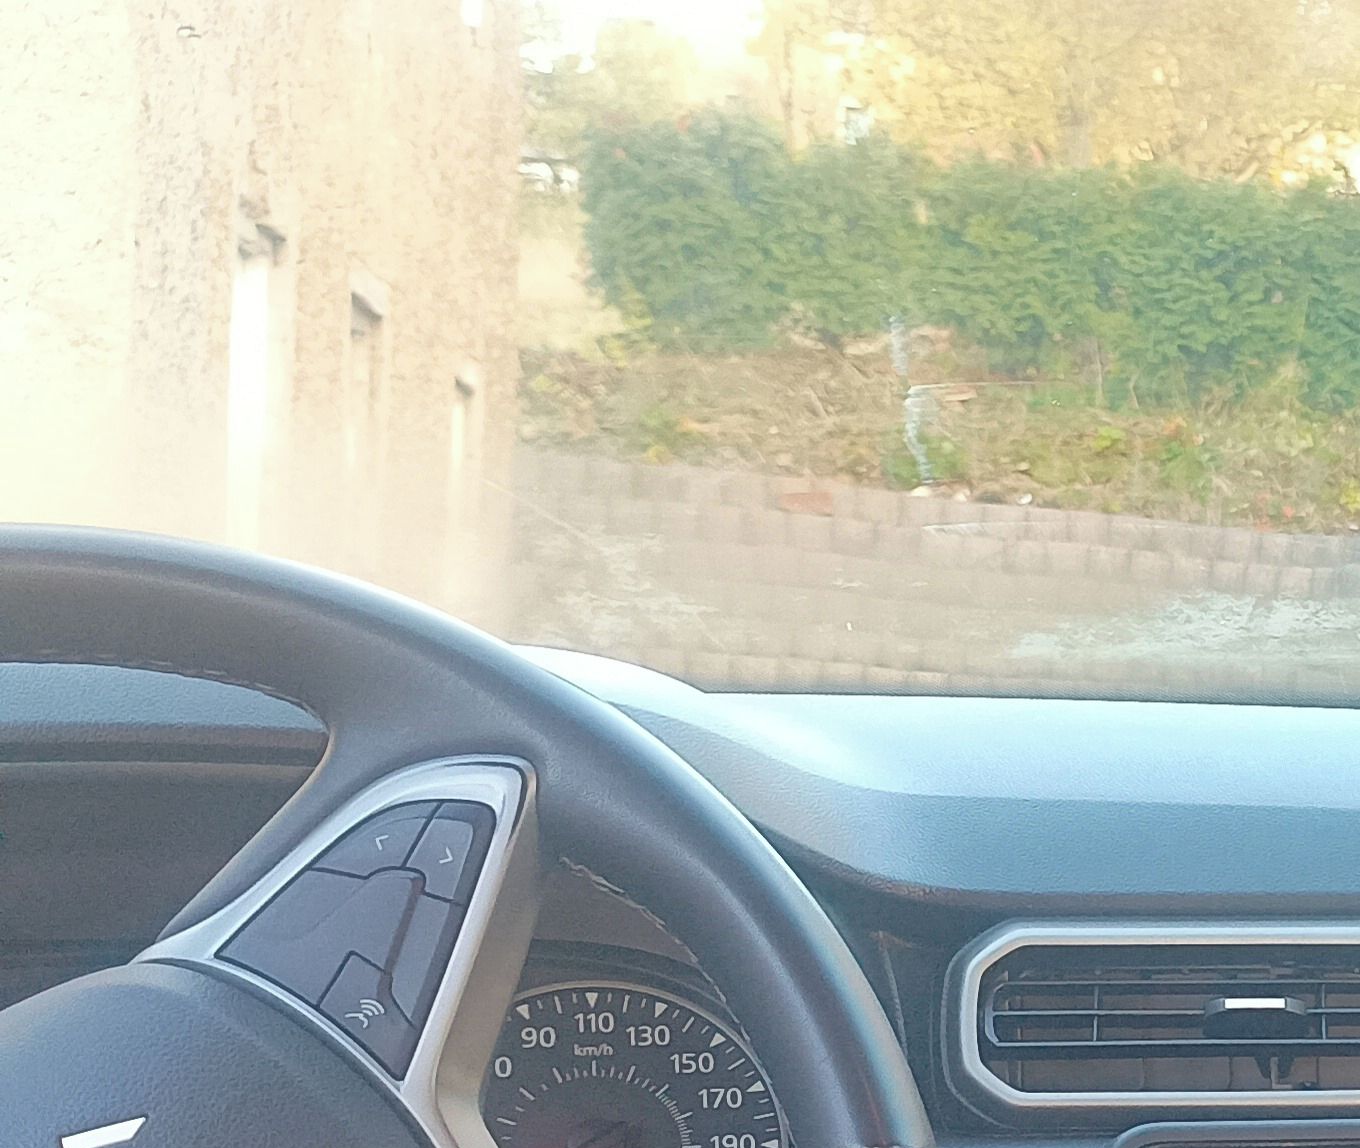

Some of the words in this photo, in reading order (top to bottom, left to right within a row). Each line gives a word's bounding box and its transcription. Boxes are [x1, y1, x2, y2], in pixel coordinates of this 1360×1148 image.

[573, 1011, 615, 1034] 110
[520, 1026, 557, 1049] 90
[625, 1024, 671, 1047] 130
[573, 1044, 614, 1057] km/h
[493, 1056, 513, 1079] 0
[669, 1052, 715, 1074] 150
[698, 1087, 743, 1109] 170
